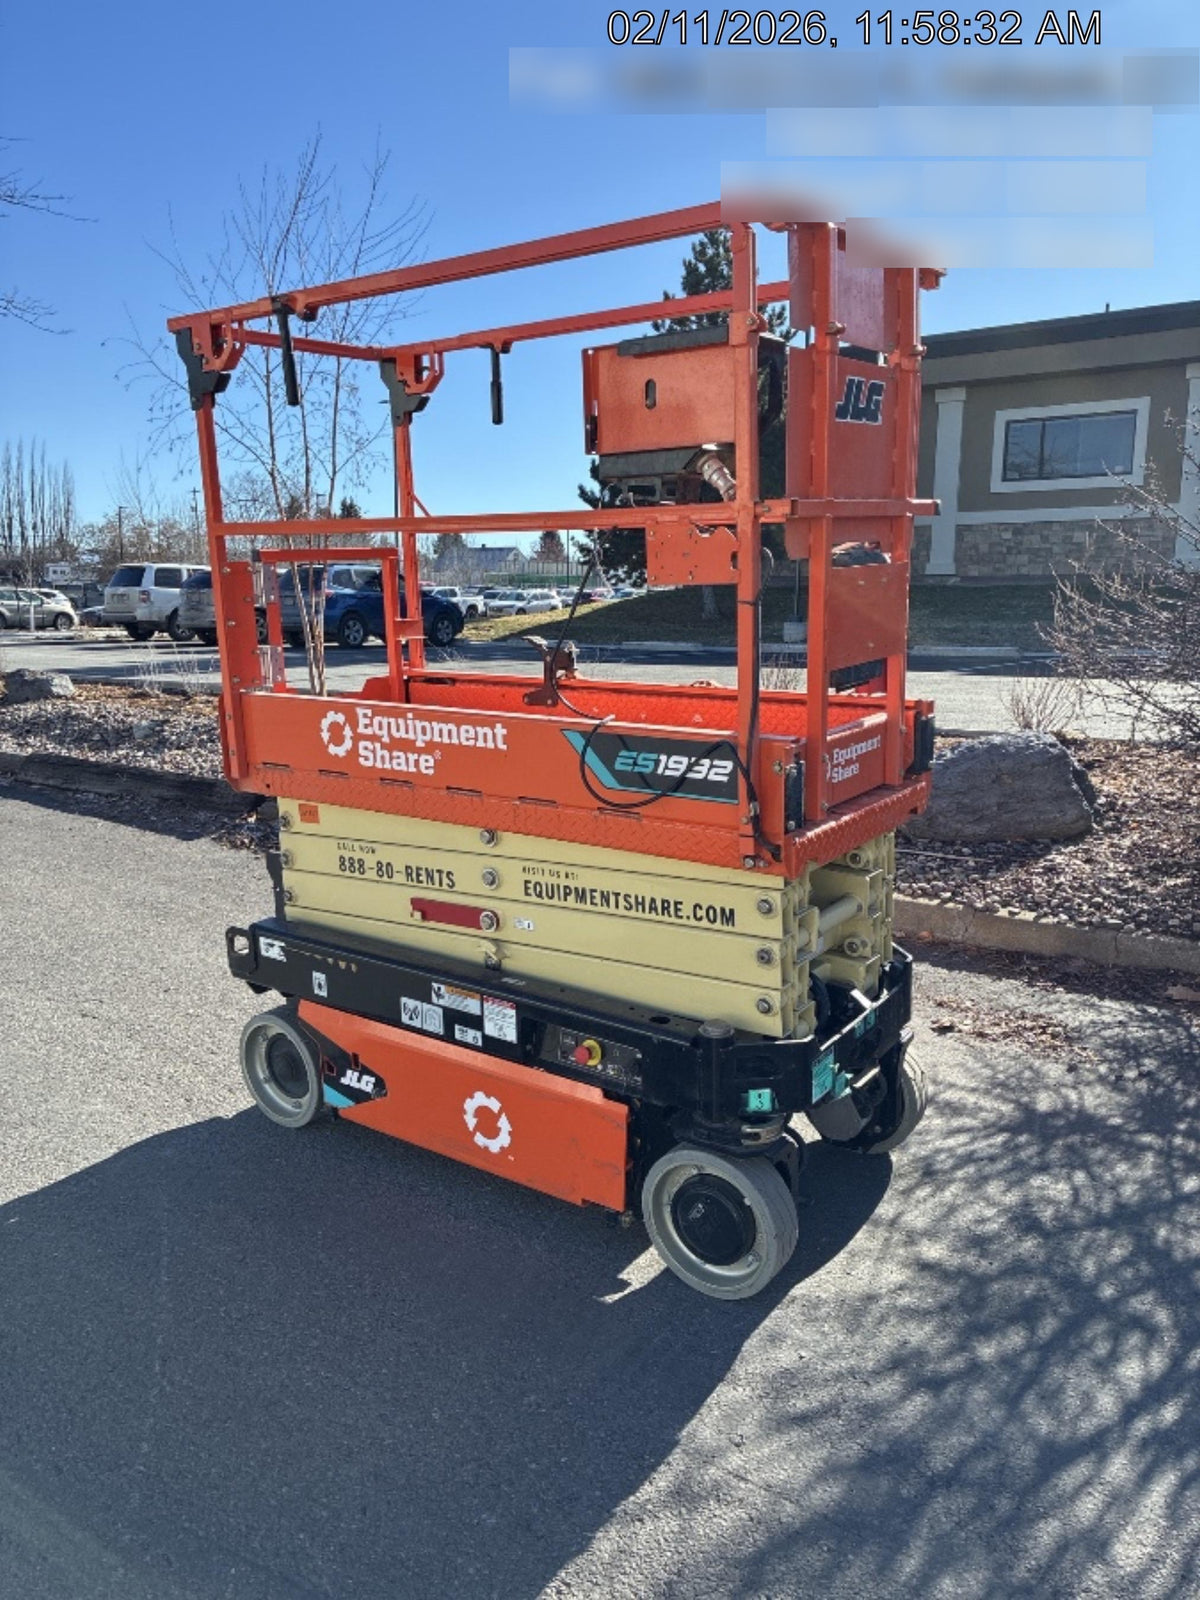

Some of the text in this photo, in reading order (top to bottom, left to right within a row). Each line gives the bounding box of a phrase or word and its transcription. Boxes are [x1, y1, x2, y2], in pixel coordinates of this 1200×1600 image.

[835, 375, 886, 425] JLG
[356, 707, 508, 750] Equipment
[614, 750, 734, 782] ES1932
[832, 735, 881, 765] Equipment
[831, 763, 860, 783] Share
[338, 854, 456, 890] 888-80-RENTS
[523, 879, 736, 927] EQUIPMENTSHARE.COM
[340, 1069, 376, 1094] JLG
